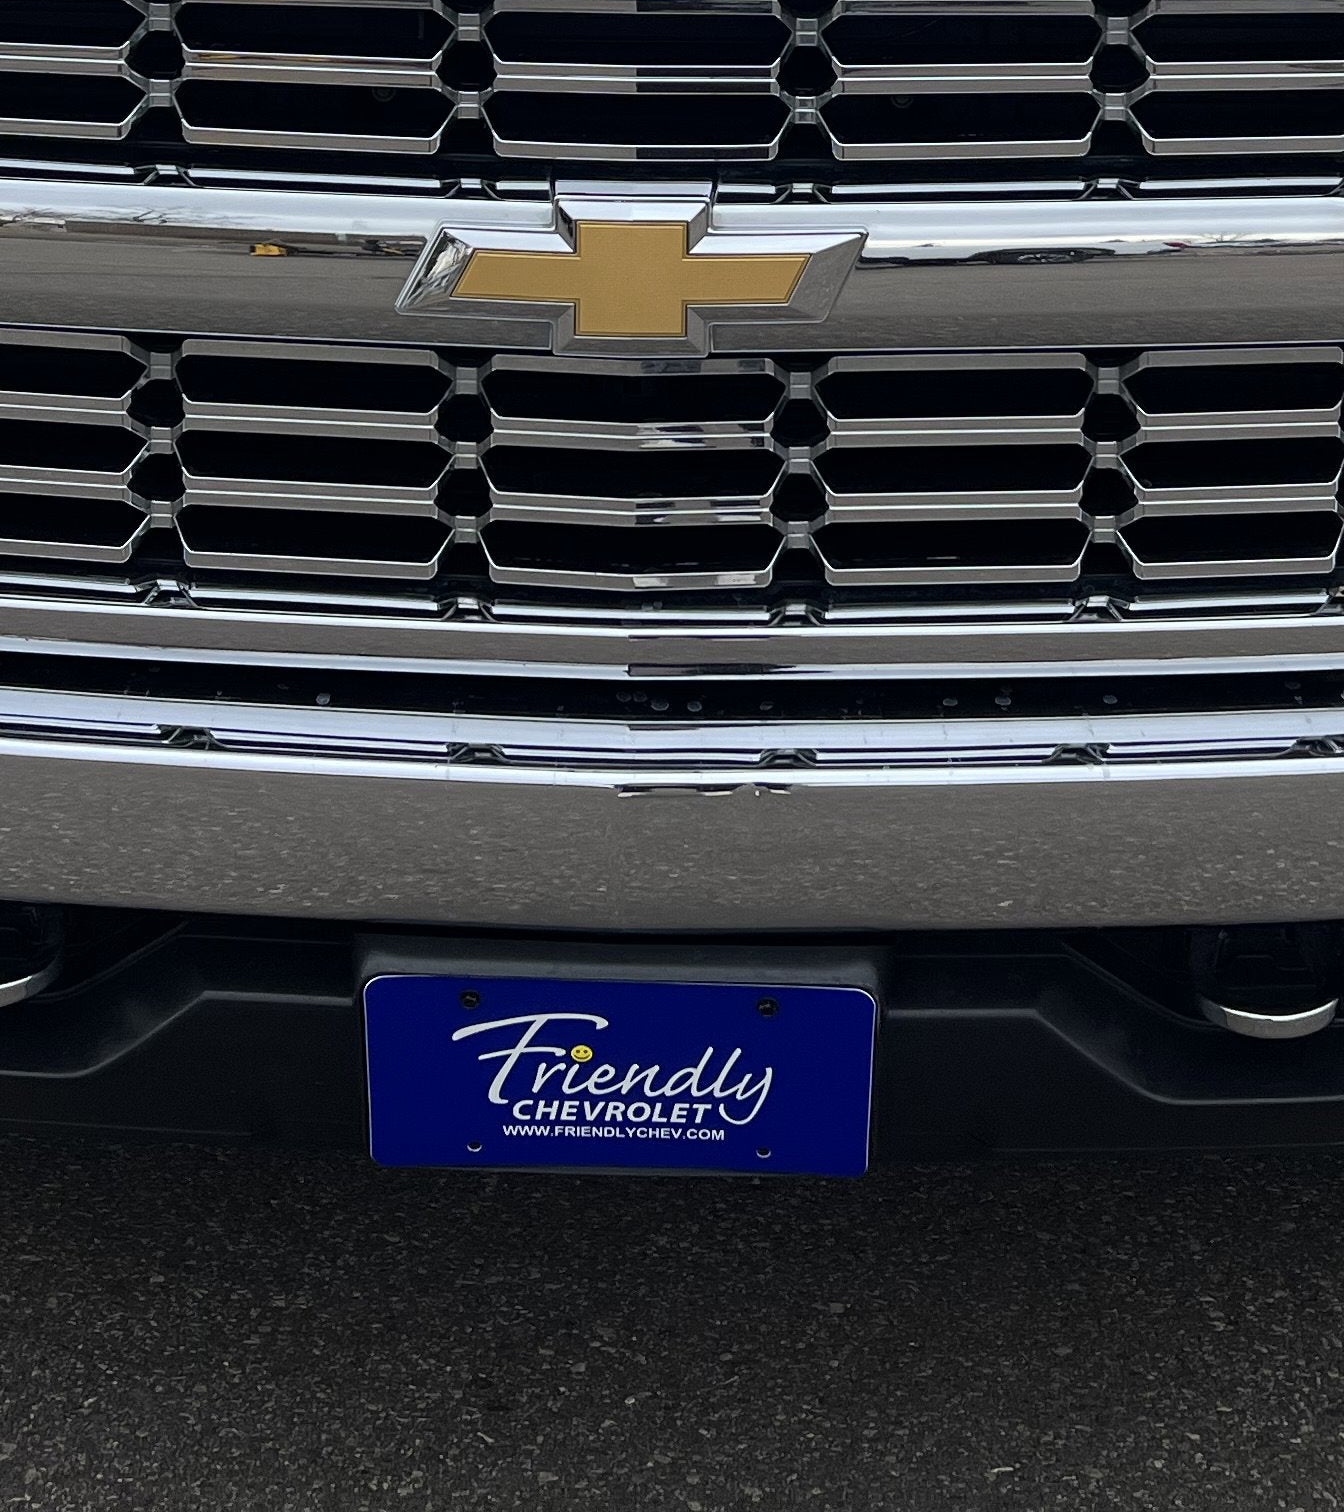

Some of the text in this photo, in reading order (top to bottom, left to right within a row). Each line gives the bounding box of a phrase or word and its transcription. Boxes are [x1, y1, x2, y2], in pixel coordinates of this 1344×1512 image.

[452, 1012, 773, 1125] Friendly
[512, 1099, 713, 1124] CHEVROLET
[502, 1125, 725, 1141] WWW.FRIENDLYCHEV.COM
